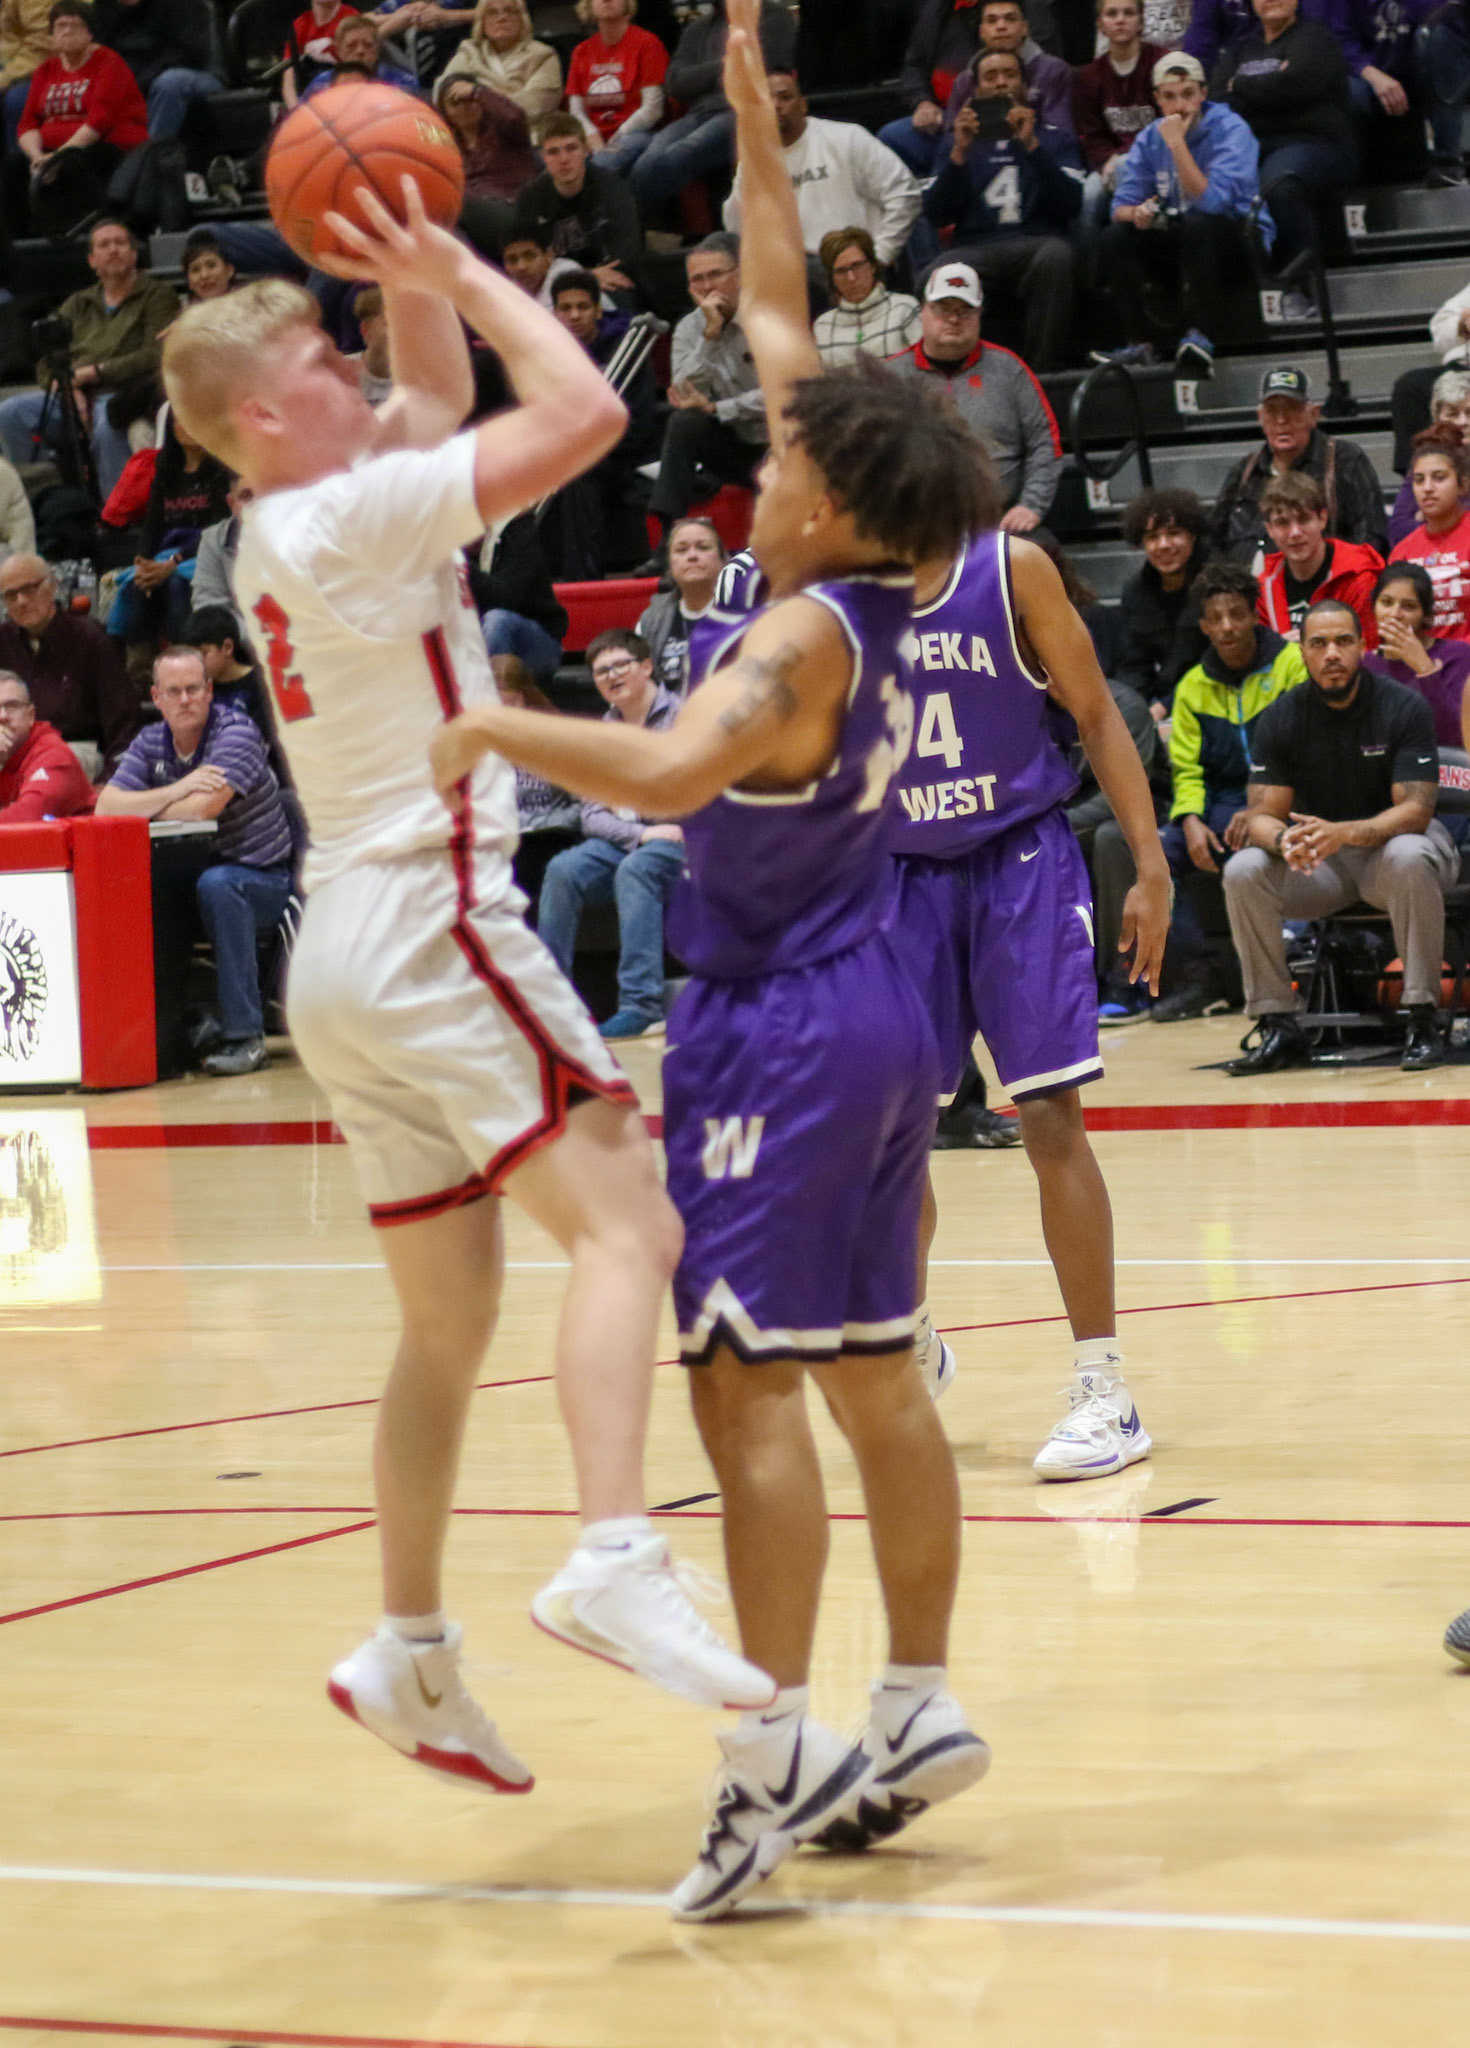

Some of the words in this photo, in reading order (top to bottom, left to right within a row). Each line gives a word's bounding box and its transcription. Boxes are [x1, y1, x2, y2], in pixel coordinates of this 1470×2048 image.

[984, 165, 1022, 223] 4
[917, 692, 965, 768] 4
[899, 775, 997, 822] WEST
[702, 1115, 766, 1179] W
